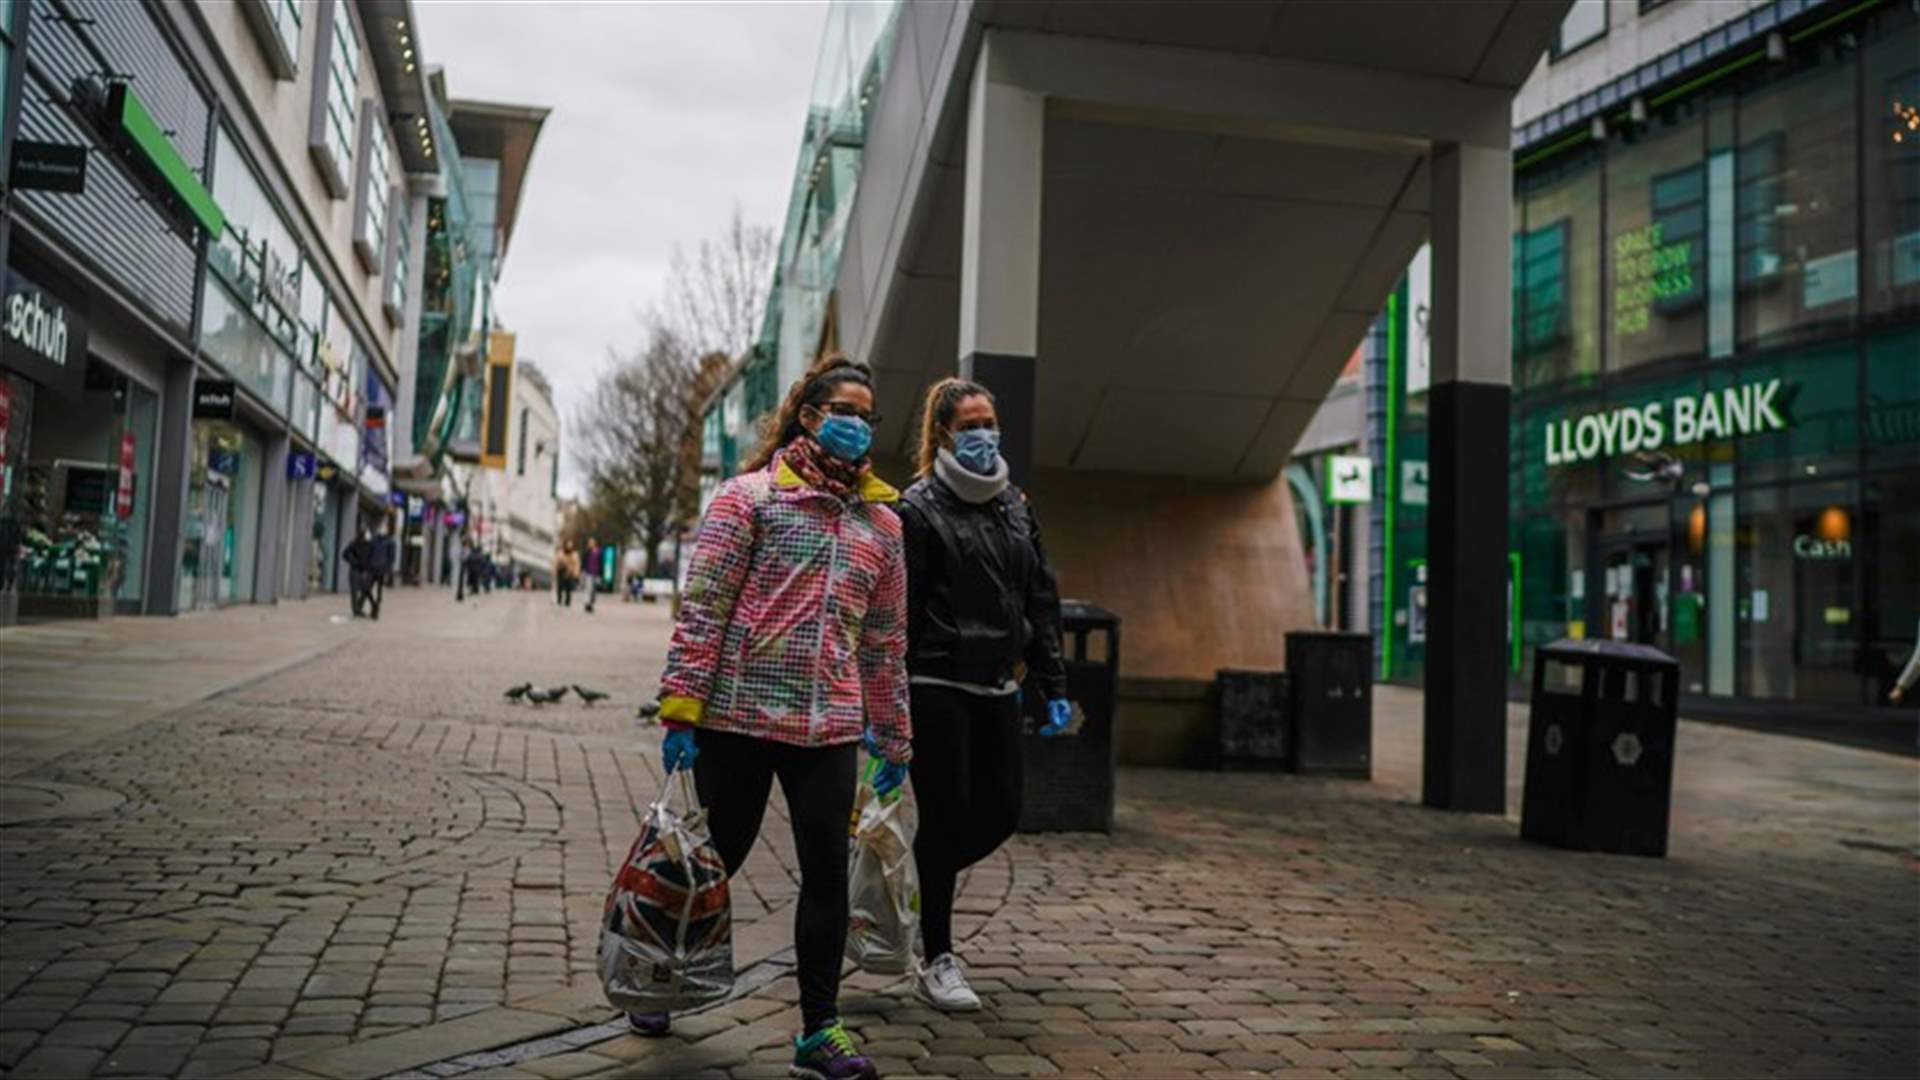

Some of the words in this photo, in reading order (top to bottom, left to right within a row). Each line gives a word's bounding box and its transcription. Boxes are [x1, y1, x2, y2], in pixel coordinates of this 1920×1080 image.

[10, 292, 68, 365] schuh
[1545, 402, 1664, 465] LLOYDS
[1673, 378, 1785, 445] BANK
[1794, 534, 1853, 558] Cash
